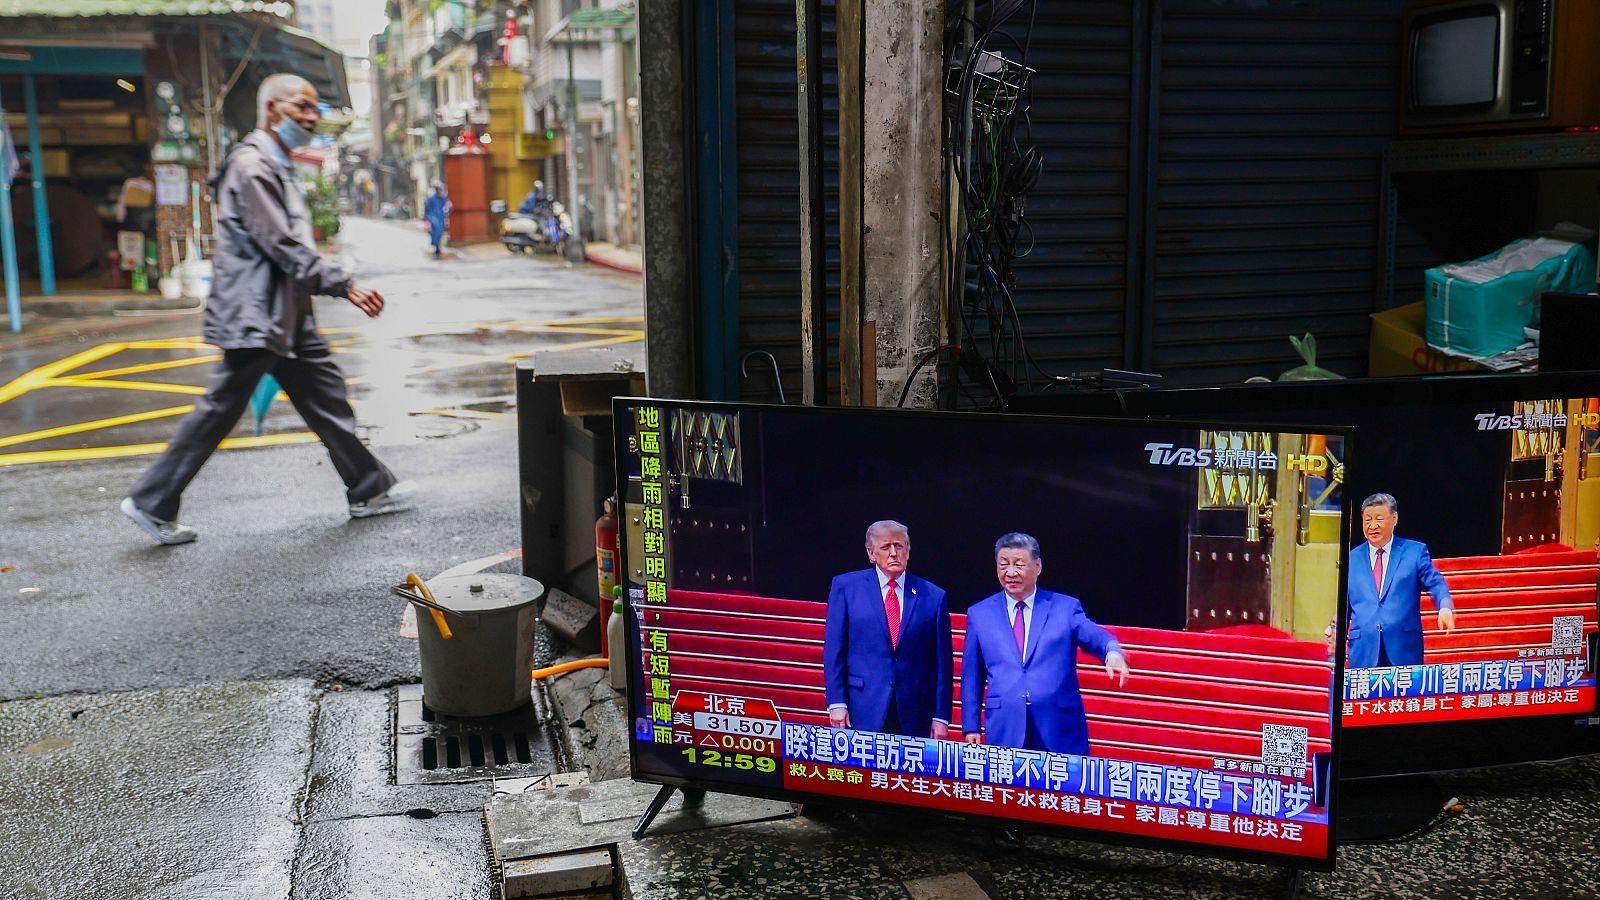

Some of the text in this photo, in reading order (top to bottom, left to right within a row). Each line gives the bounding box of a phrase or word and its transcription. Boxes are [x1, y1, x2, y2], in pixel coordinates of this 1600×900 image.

[1474, 412, 1600, 430] TVBS 新聞台 HD
[1144, 443, 1328, 472] TVBS 新聞台 HD
[1420, 656, 1585, 694] 川習兩度停下腳步
[704, 695, 746, 715] 北京
[1461, 689, 1579, 709] 家屬:尊重他決定
[673, 711, 693, 744] 美元
[708, 716, 778, 736] 31.507
[721, 734, 775, 753] 0.001
[681, 748, 776, 773] 12:59
[785, 724, 1312, 820] 睽違9年訪京 川普講不停 川習兩度停下腳步
[1213, 758, 1307, 779] 更多新聞在這裡
[789, 762, 1303, 841] 救人喪命 男大生大稻埕下水救翁身亡 家屬:尊重他決定
